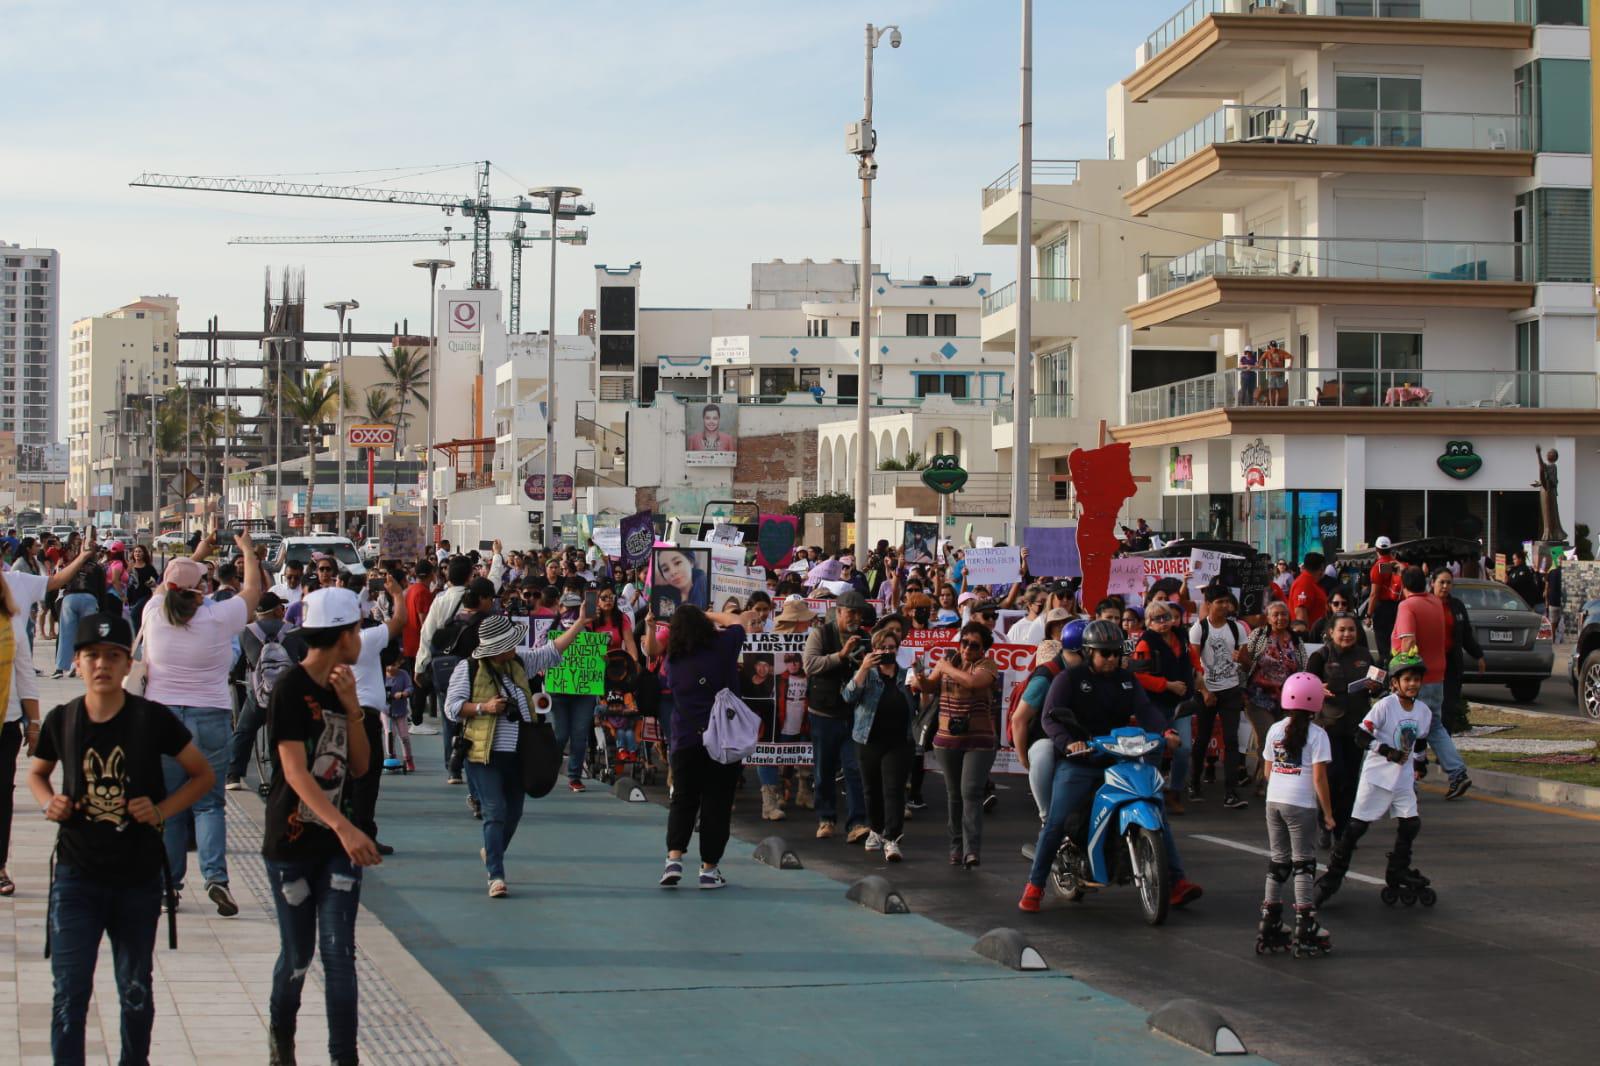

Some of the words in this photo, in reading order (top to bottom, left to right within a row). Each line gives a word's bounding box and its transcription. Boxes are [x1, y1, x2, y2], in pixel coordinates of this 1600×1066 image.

[352, 429, 392, 443] OXXO
[752, 633, 780, 642] LAS
[913, 630, 951, 639] ESTAS?
